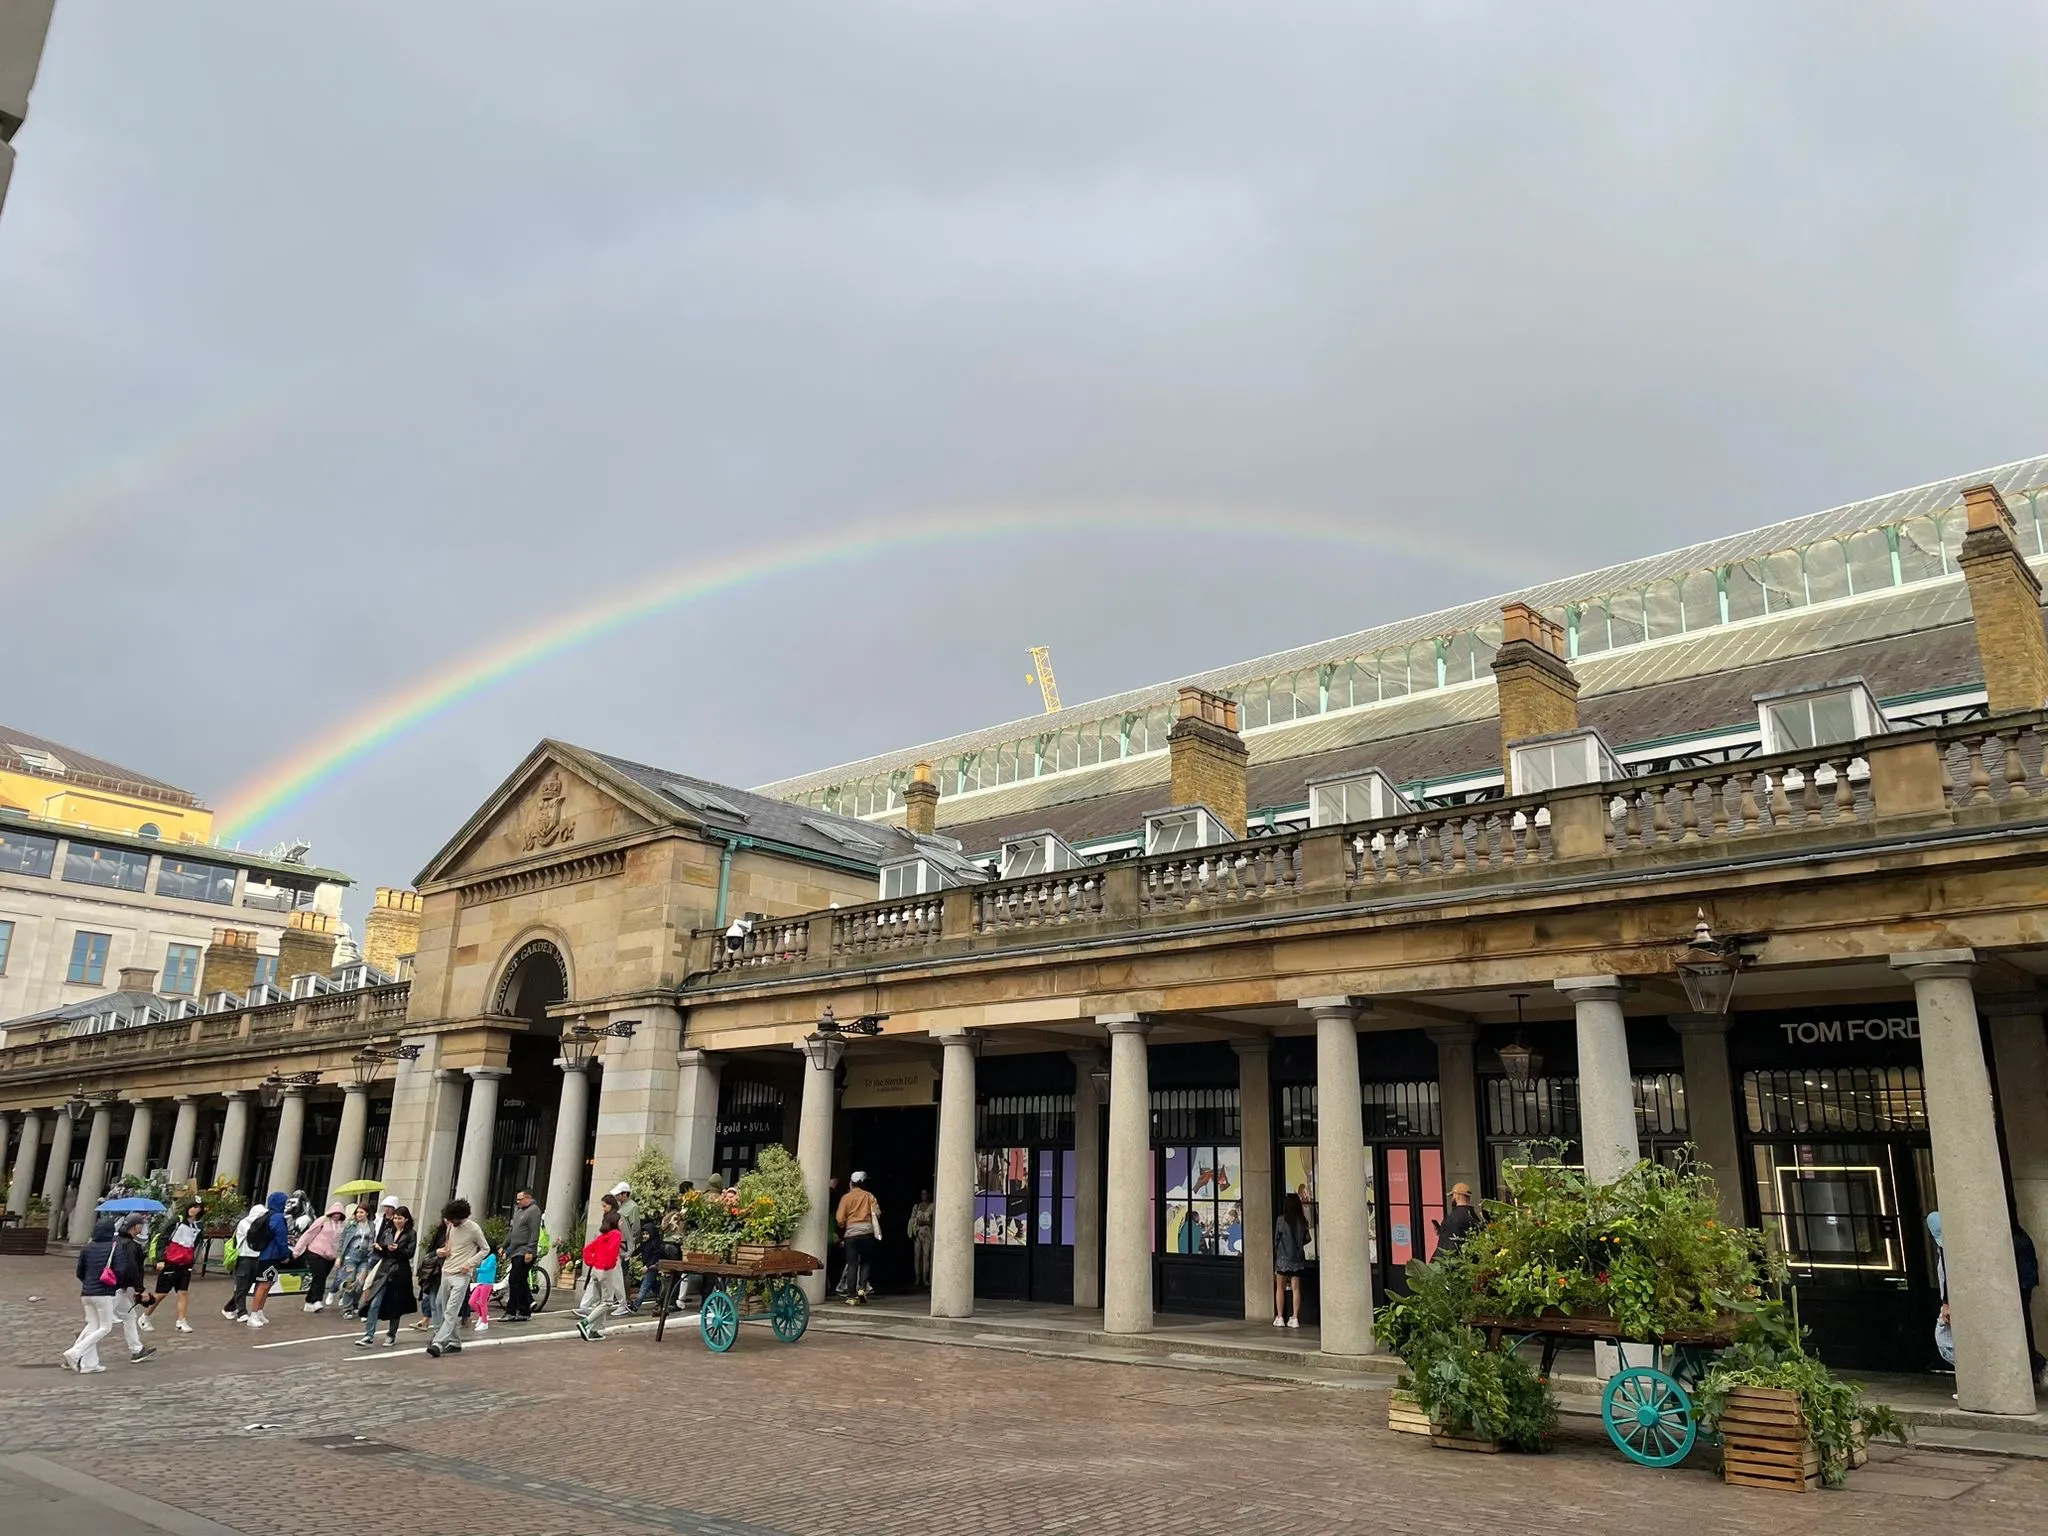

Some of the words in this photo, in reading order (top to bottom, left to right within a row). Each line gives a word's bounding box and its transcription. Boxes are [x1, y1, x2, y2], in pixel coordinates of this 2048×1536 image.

[520, 942, 555, 960] GARDEN
[1780, 1021, 1842, 1044] TOM
[1847, 1017, 1920, 1041] FORD
[864, 1079, 872, 1088] To
[873, 1077, 883, 1087] the
[884, 1076, 903, 1086] North
[904, 1075, 918, 1085] Hall
[723, 1122, 741, 1135] gold
